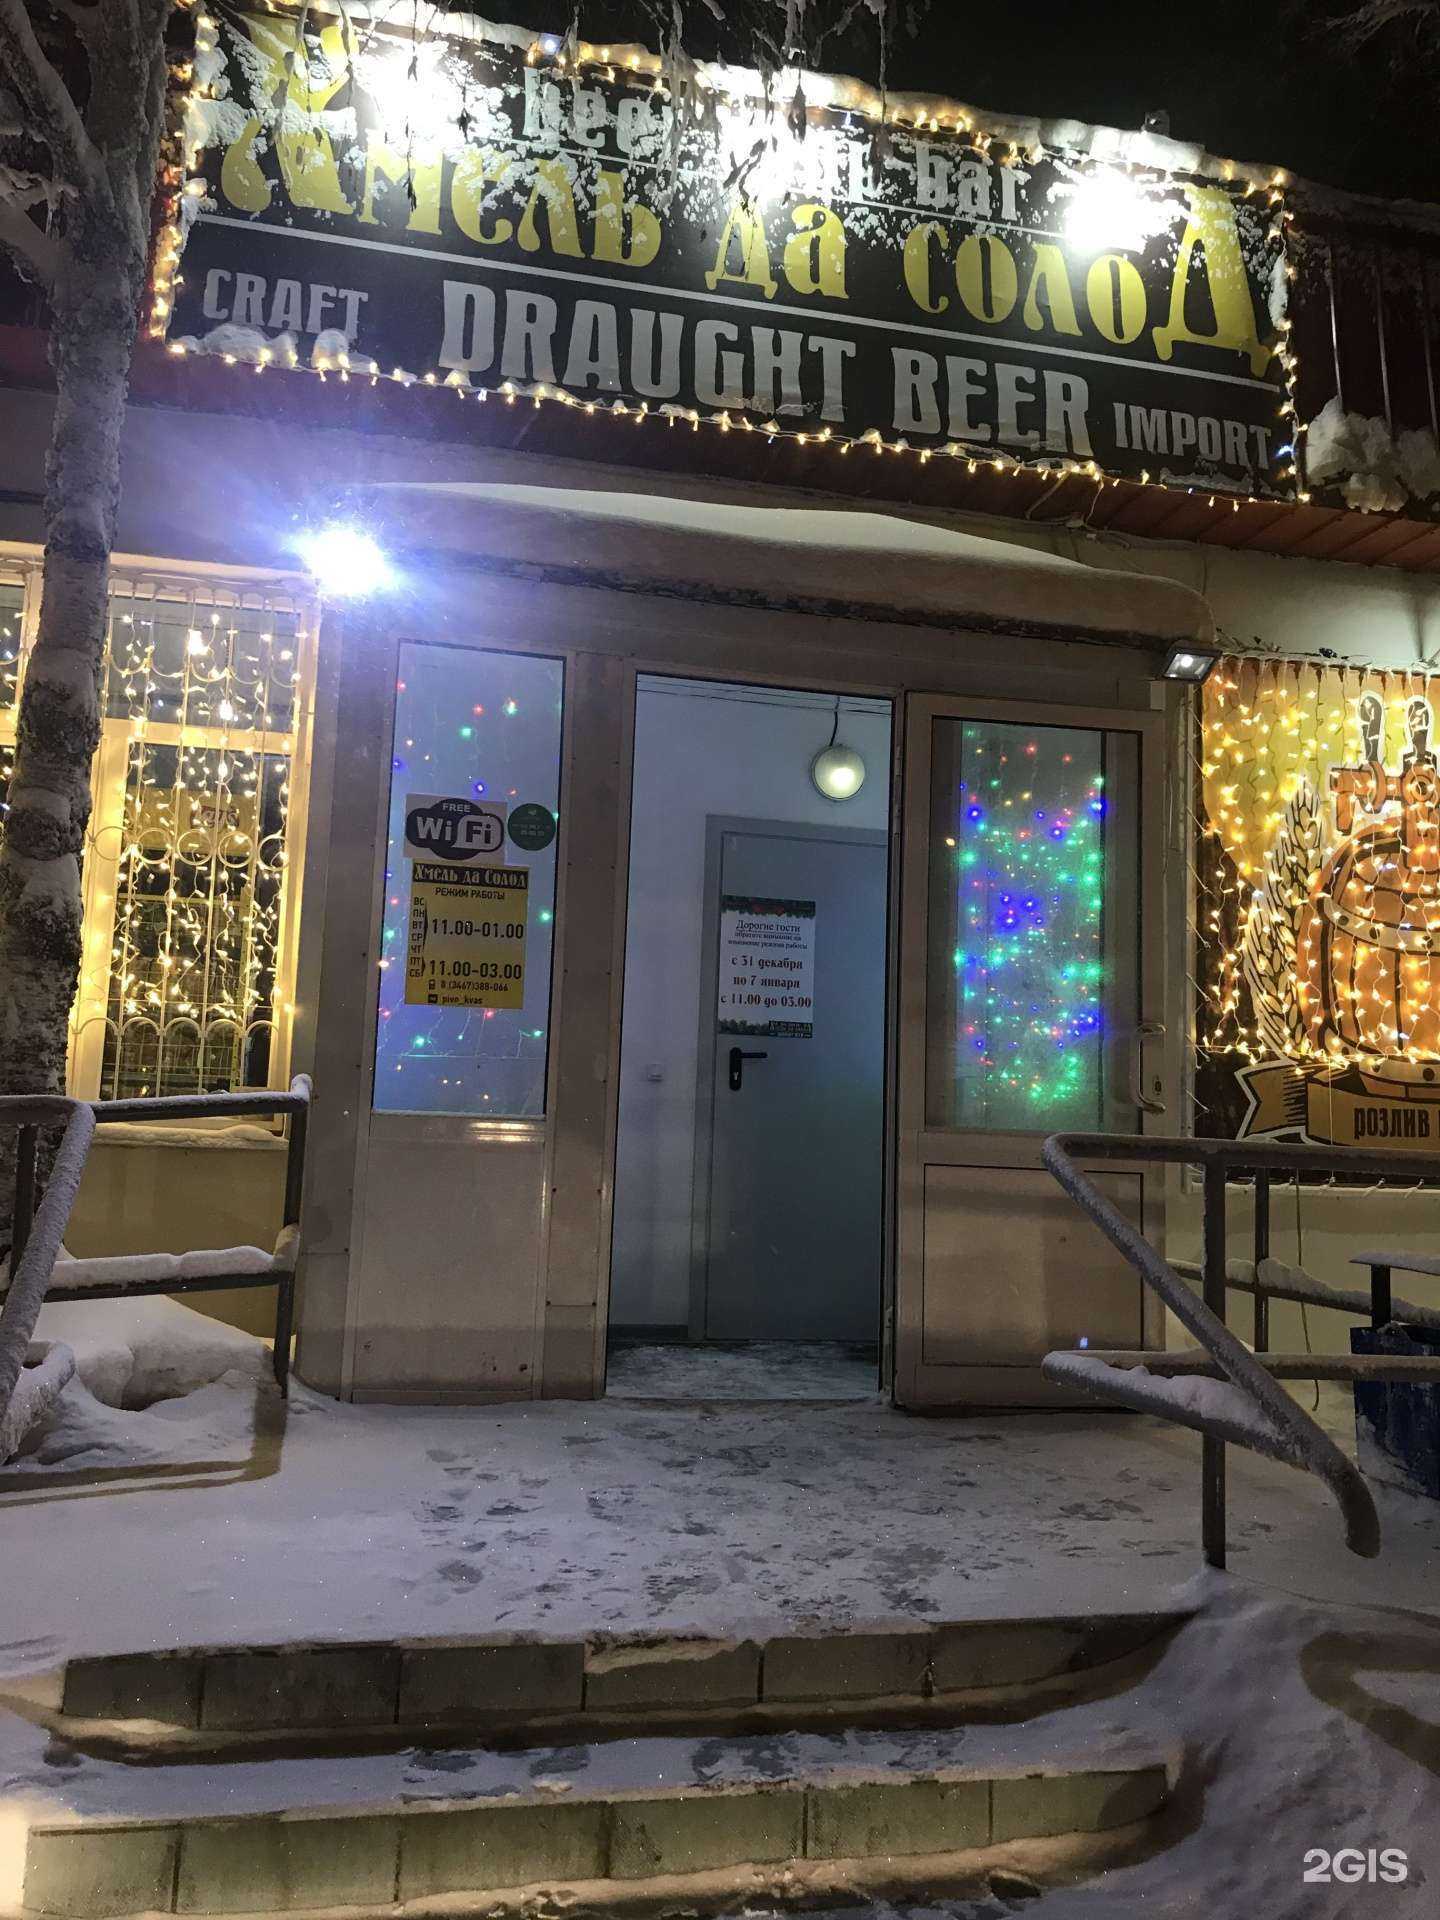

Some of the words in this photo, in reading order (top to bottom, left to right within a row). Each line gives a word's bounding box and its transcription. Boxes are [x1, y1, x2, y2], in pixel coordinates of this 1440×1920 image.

[202, 268, 369, 339] CRAFT
[438, 280, 856, 422] DRAUGHT
[891, 347, 1094, 456] BEER
[1112, 402, 1272, 469] IMPORT
[442, 802, 471, 813] FREE
[414, 864, 458, 882] Хмель
[463, 870, 480, 885] да
[435, 887, 469, 898] РЕЖИМ
[471, 889, 505, 900] РАБОТЫ
[413, 897, 425, 906] ВС
[413, 909, 425, 918] ПН
[412, 921, 423, 930] ВТ
[432, 918, 524, 939] 11.00-01.00
[736, 919, 774, 932] Дорогие
[776, 923, 801, 933] гости
[411, 933, 423, 942] СР
[410, 944, 422, 954] ЧТ
[410, 957, 421, 966] ПТ
[731, 957, 738, 965] с
[741, 955, 753, 966] 31
[758, 957, 803, 971] декабря
[409, 969, 420, 978] СБ
[429, 960, 522, 979] 11.00-03.00
[733, 976, 747, 985] по
[750, 975, 757, 986] 7
[760, 977, 800, 990] января
[720, 995, 727, 1003] с
[731, 993, 761, 1005] 11.00
[764, 997, 778, 1008] до
[781, 995, 812, 1008] 03.00
[1354, 1107, 1430, 1140] розлив
